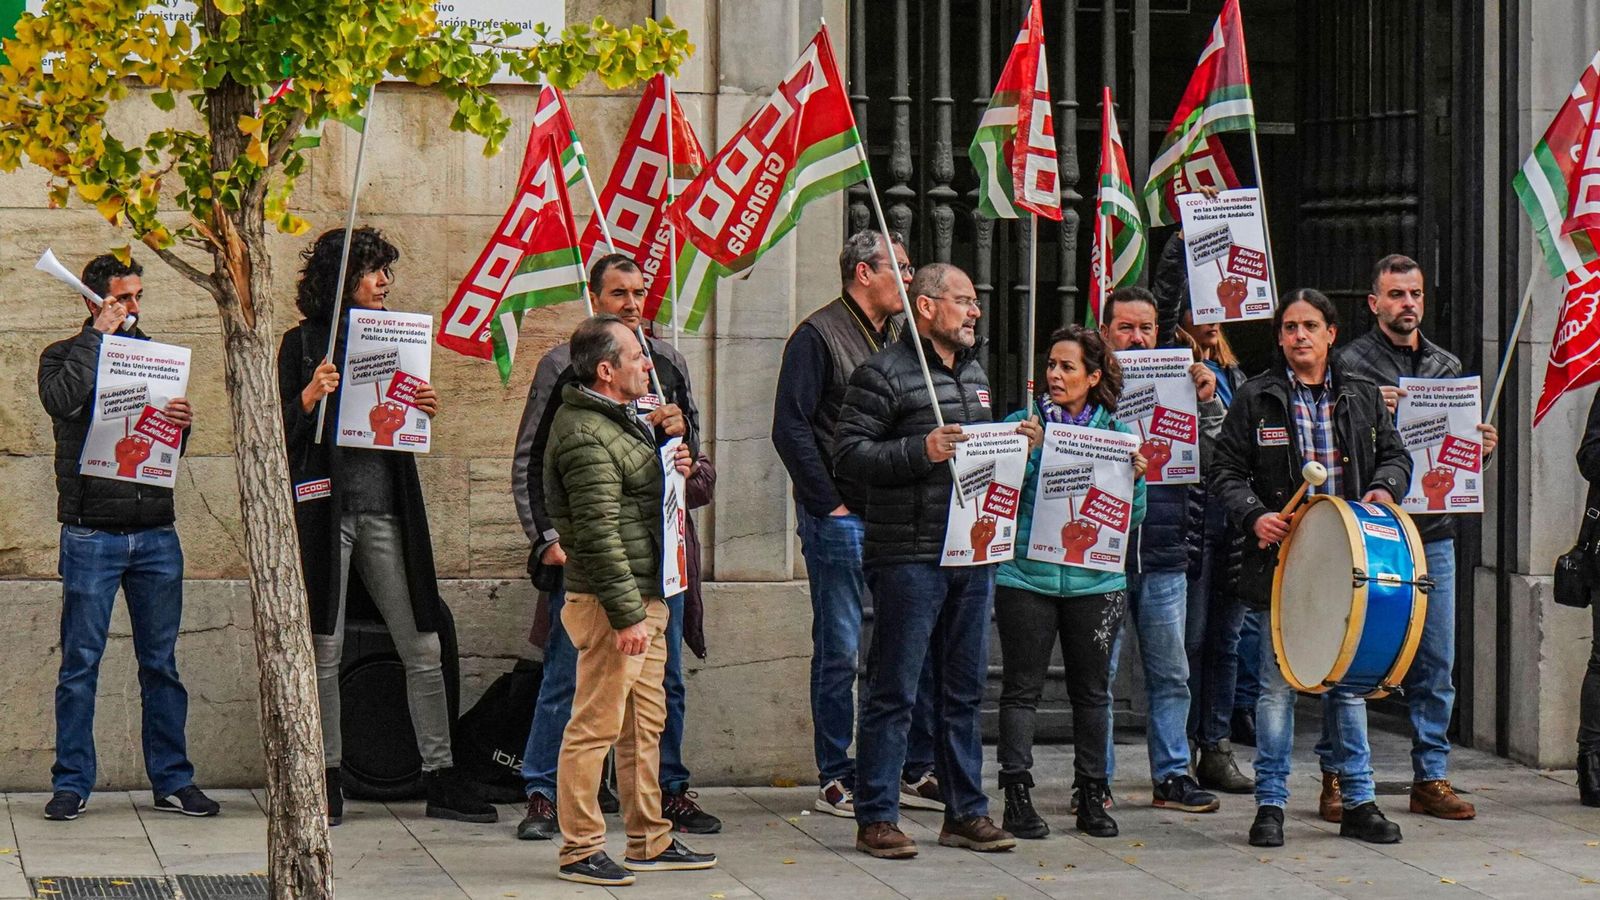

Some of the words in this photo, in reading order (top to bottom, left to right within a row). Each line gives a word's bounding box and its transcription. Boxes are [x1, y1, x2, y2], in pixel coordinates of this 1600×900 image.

[384, 328, 425, 336] Universidades
[361, 334, 388, 342] Públicas
[155, 357, 185, 366] movilizan
[110, 368, 136, 376] Públicas
[133, 363, 178, 373] Universidades
[1053, 430, 1071, 438] CCOO
[1104, 438, 1136, 448] movilizan
[1081, 443, 1128, 455] Universidades
[1056, 447, 1083, 457] Públicas
[1095, 454, 1128, 463] Andalucía
[1090, 500, 1106, 510] PAGA
[1112, 508, 1125, 518] LAS
